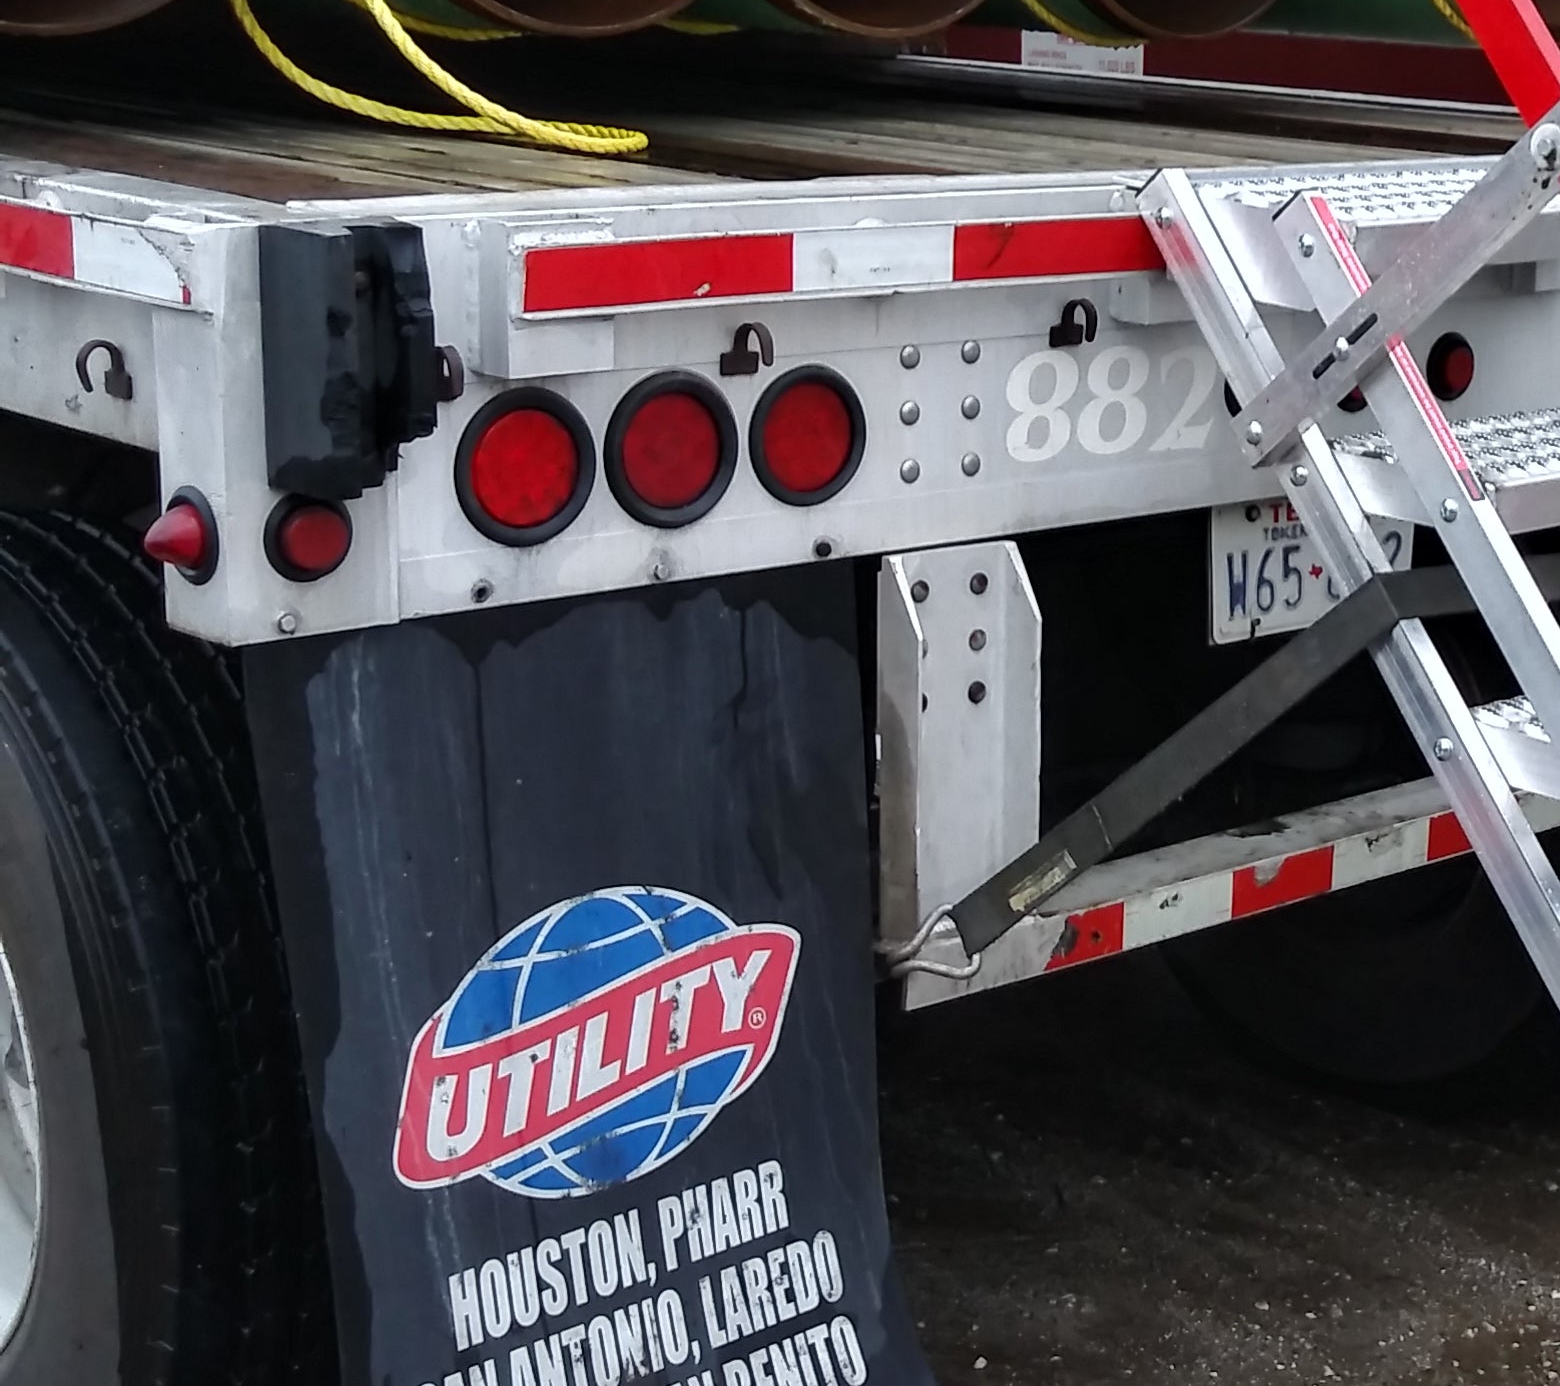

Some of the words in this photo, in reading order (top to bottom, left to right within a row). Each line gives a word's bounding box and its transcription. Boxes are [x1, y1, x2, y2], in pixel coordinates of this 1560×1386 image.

[1006, 345, 1219, 462] 882
[425, 949, 769, 1163] UTILITY
[448, 1207, 656, 1353] HOUSTON,
[657, 1160, 790, 1273] PHARR
[699, 1230, 846, 1344] LAREDO
